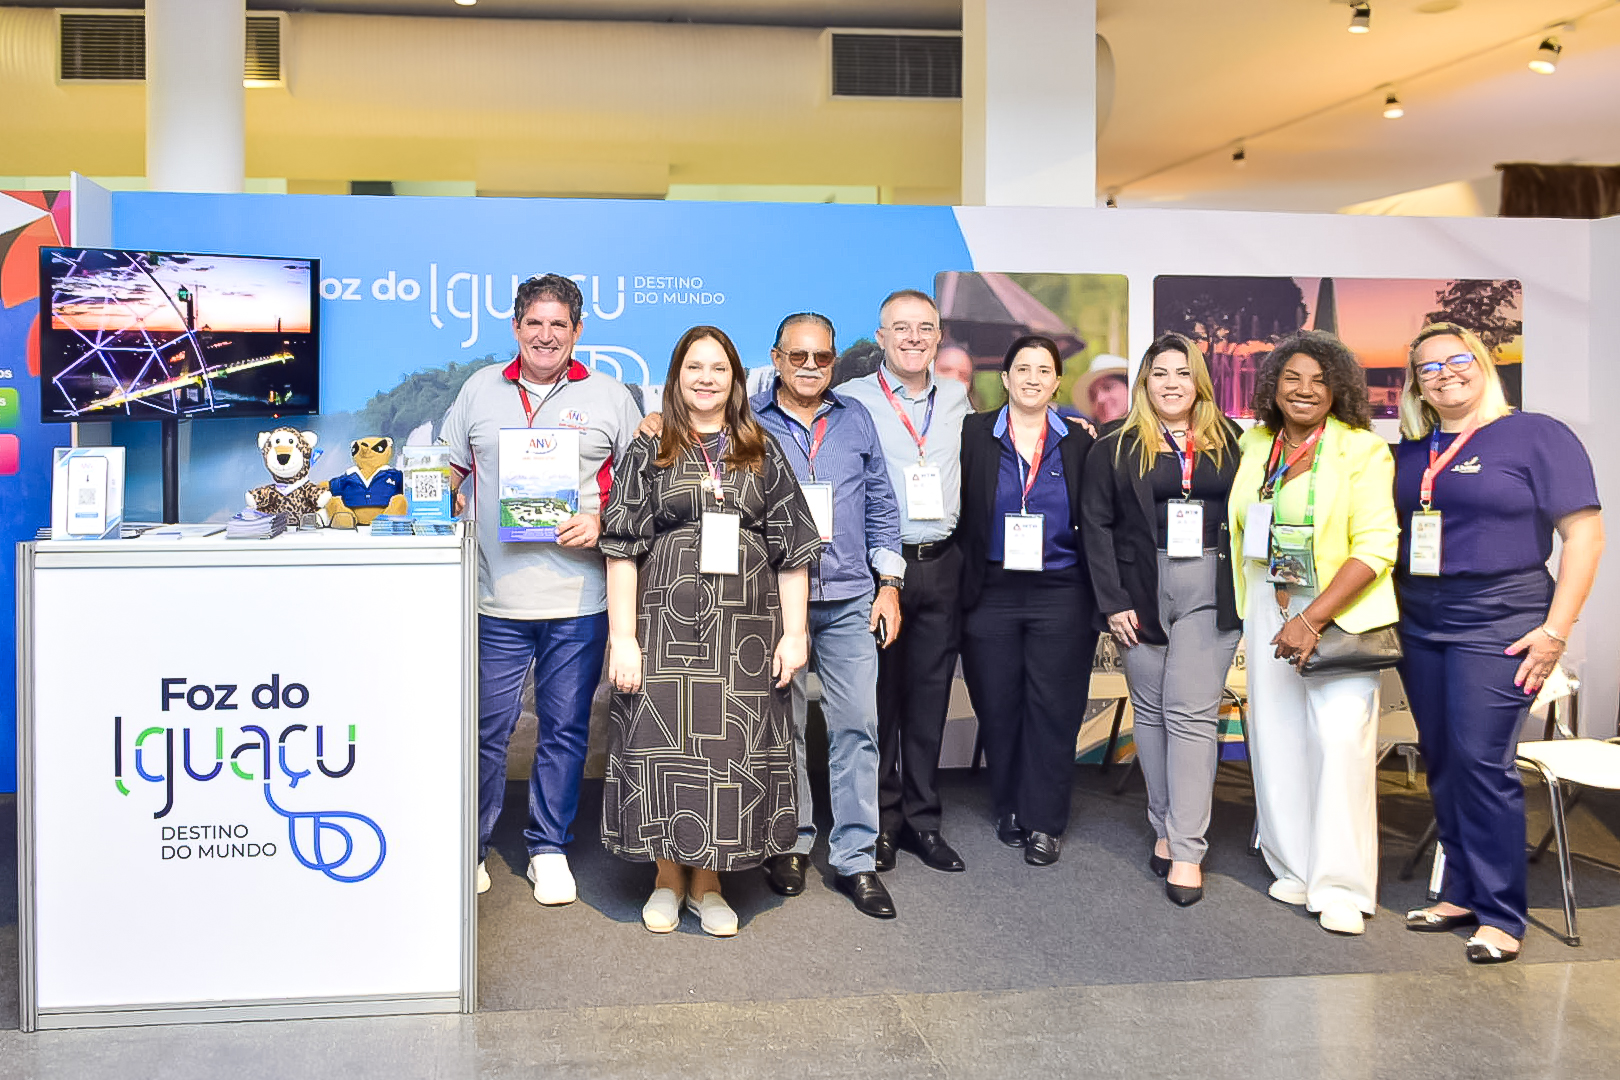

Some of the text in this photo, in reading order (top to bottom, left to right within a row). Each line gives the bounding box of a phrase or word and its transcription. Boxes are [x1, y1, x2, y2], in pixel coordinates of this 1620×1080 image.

[634, 276, 704, 290] DESTINO
[319, 263, 625, 349] oz do Iguu
[634, 291, 725, 305] DO MUNDO
[529, 438, 552, 449] ANV
[161, 673, 310, 711] Foz do
[114, 716, 356, 820] Iguaçu
[161, 824, 249, 841] DESTINO
[161, 842, 277, 860] DO MUNDO
